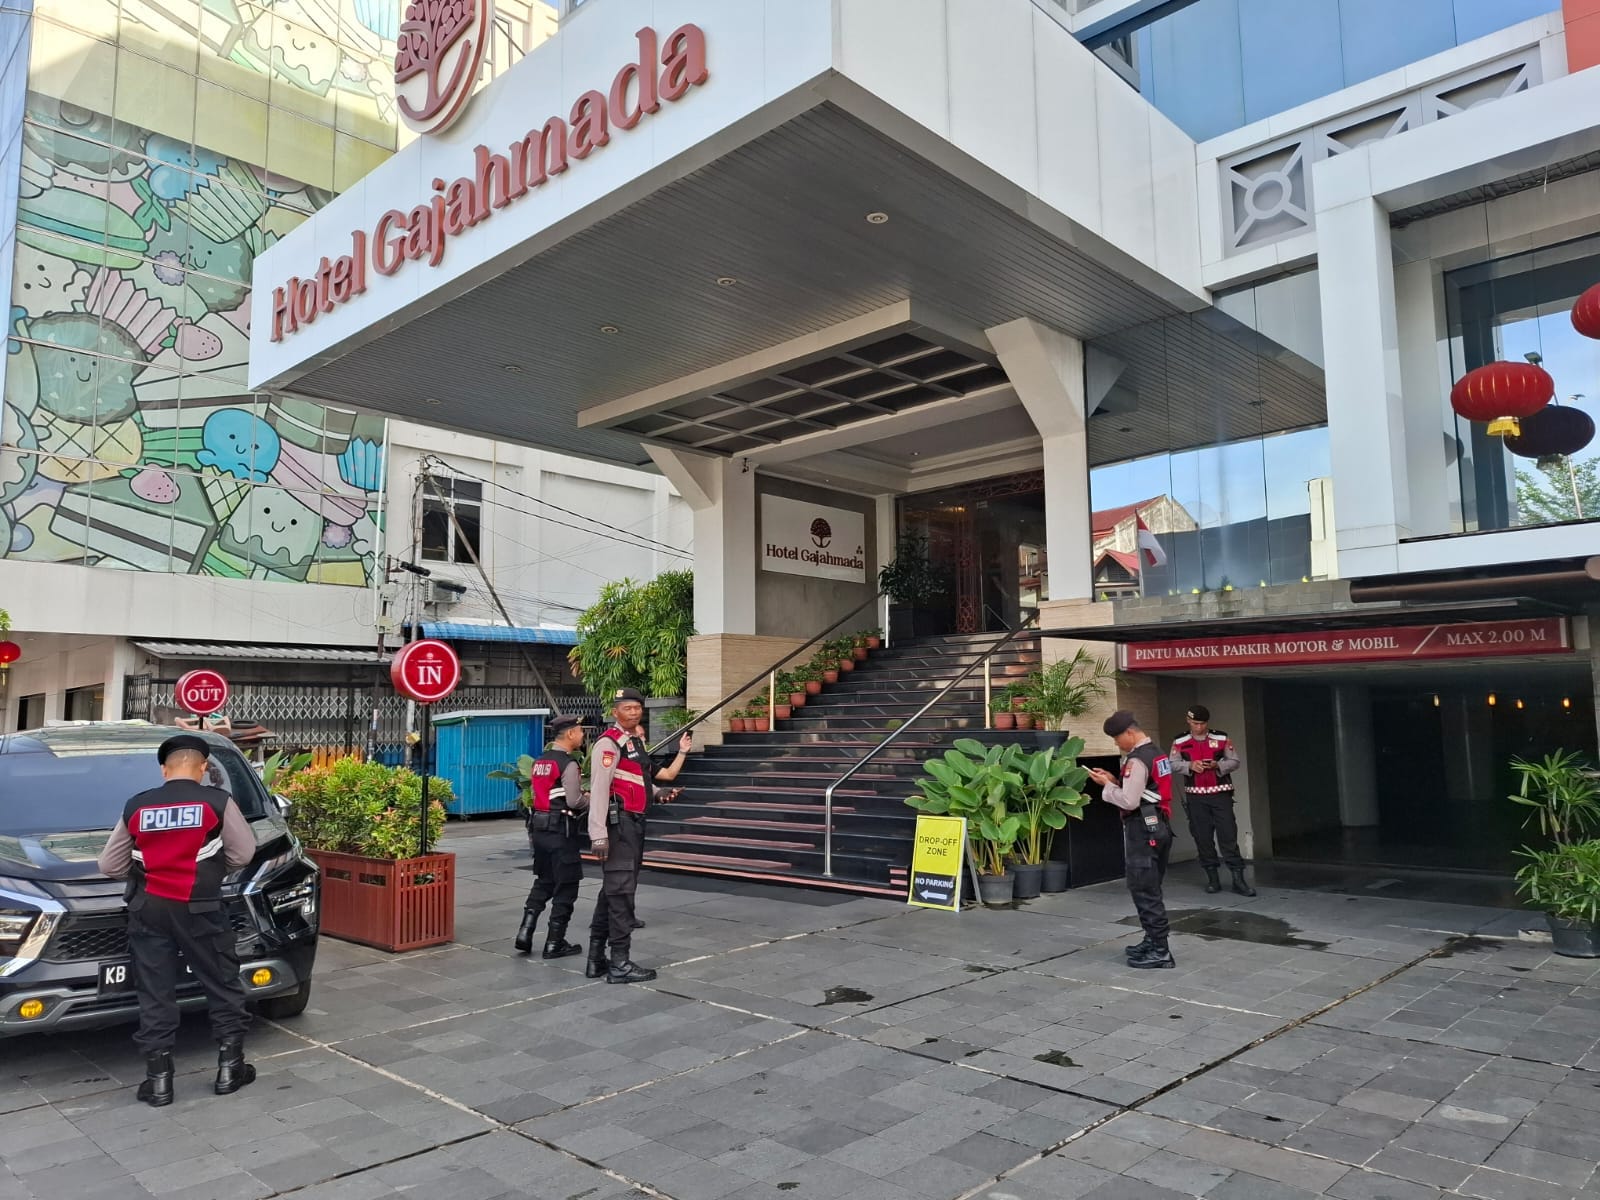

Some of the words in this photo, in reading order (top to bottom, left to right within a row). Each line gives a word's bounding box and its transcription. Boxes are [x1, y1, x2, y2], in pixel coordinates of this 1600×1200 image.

[270, 230, 367, 342] Hotel
[372, 23, 709, 276] Gajahmada
[766, 543, 799, 561] Hotel
[801, 549, 864, 570] Gajahmada
[1446, 631, 1484, 646] MAX
[1488, 630, 1524, 643] 2.00
[1530, 628, 1546, 641] M
[1135, 648, 1172, 660] PINTU
[1175, 646, 1219, 658] MASUK
[1223, 643, 1271, 656] PARKIR
[1274, 640, 1328, 654] MOTOR
[1331, 639, 1344, 651] &
[1348, 636, 1399, 650] MOBIL
[417, 665, 443, 685] IN
[187, 688, 222, 702] OUT
[142, 806, 201, 830] POLISI
[919, 836, 957, 846] DROP-OFF
[926, 847, 948, 856] ZONE
[915, 877, 924, 885] NO
[925, 878, 954, 889] PARKING
[105, 965, 126, 985] KB
